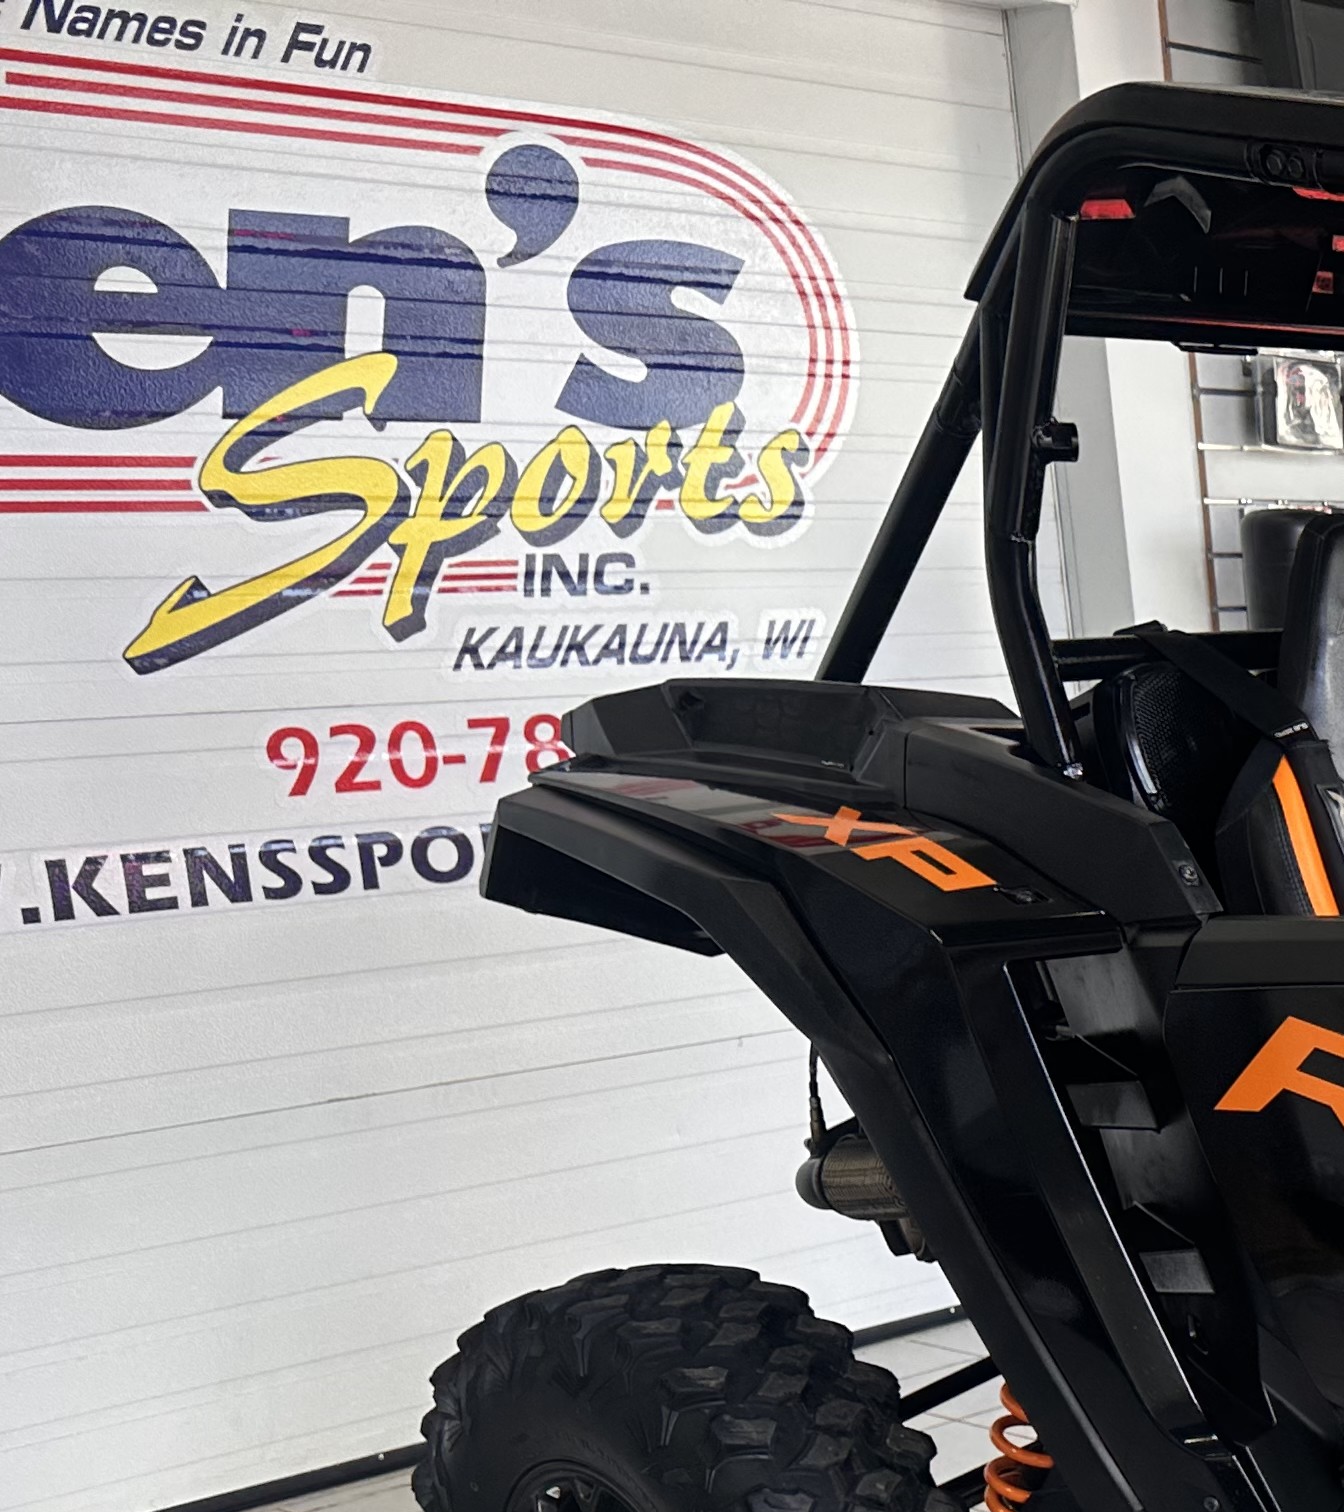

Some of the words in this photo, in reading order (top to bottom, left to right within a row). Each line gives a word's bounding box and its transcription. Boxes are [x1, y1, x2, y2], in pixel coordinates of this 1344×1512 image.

[20, 0, 207, 52] Names
[221, 13, 267, 60] in
[280, 20, 373, 73] Fun
[124, 352, 812, 675] Sports
[521, 551, 651, 600] INC.
[452, 620, 742, 673] KAUKAUNA,
[763, 619, 813, 661] WI
[20, 822, 496, 925] .KENSSPO
[772, 806, 998, 893] XP
